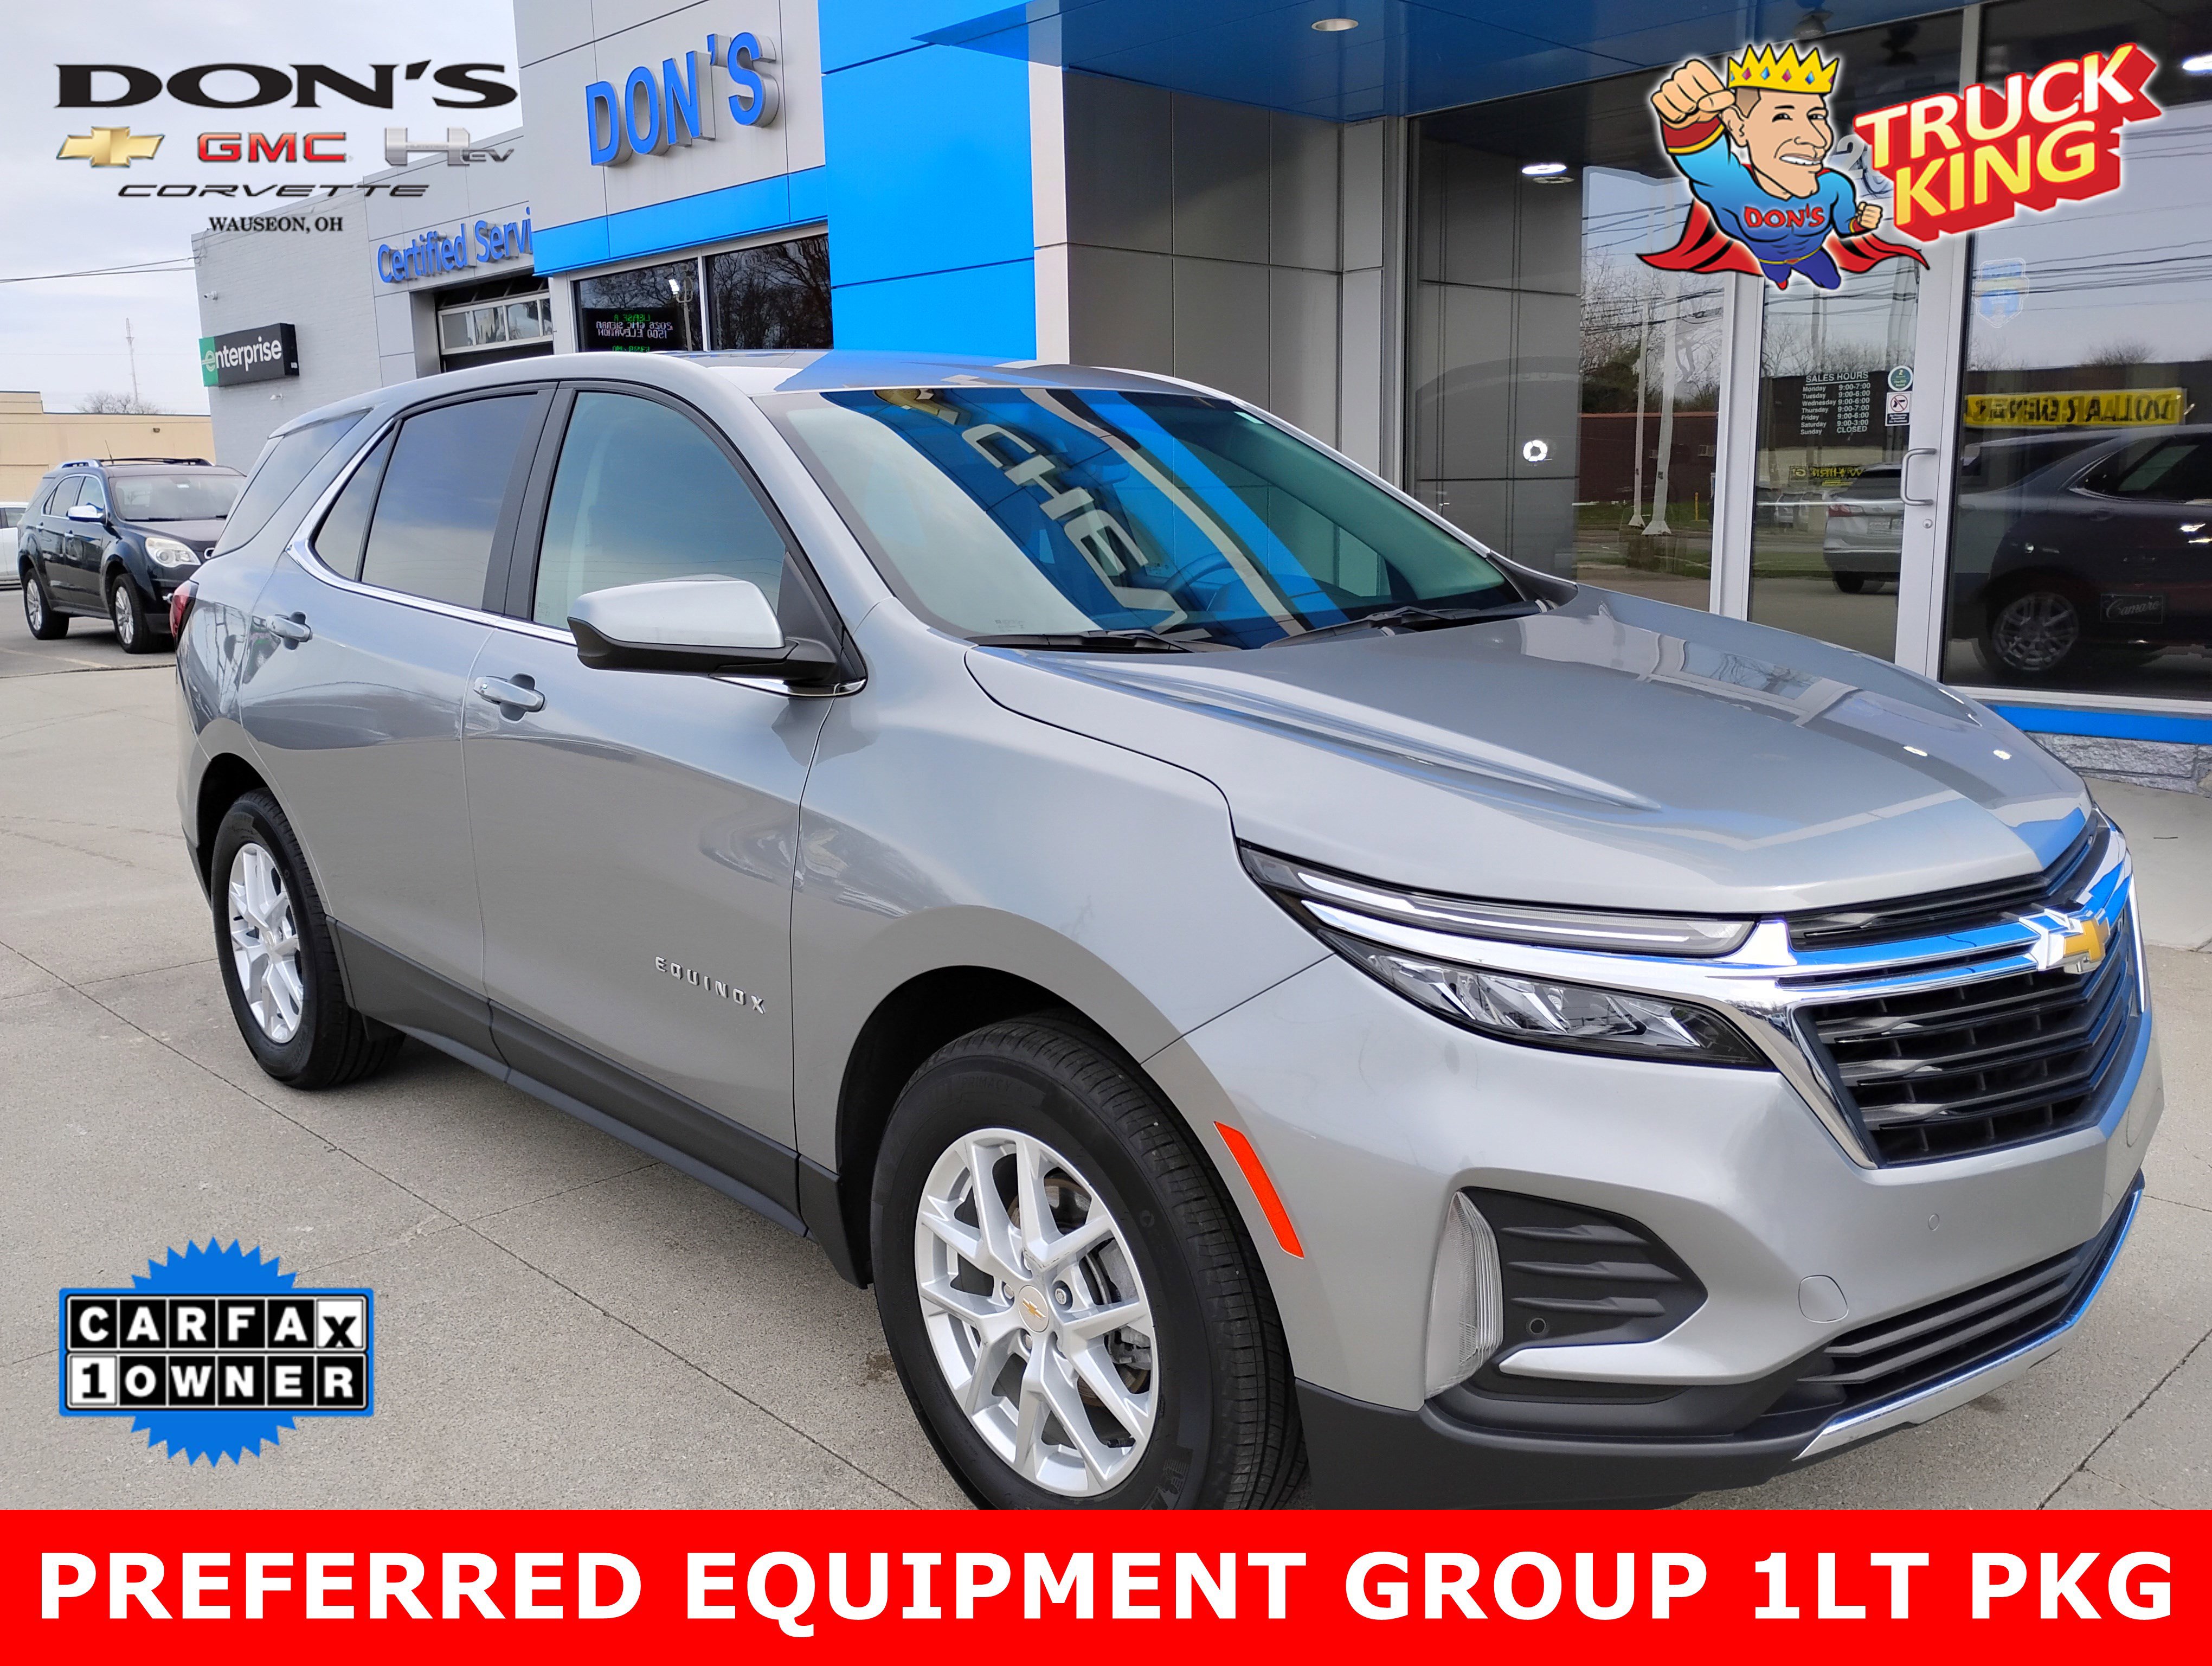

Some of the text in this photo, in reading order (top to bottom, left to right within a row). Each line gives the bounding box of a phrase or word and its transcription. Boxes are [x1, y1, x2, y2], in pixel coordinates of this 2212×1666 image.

[586, 31, 779, 166] DON'S
[377, 223, 468, 284] Certified
[201, 335, 282, 372] enterprise
[1805, 371, 1869, 383] SALES HOURS
[1838, 383, 1871, 391] 9:00-7:00
[1838, 390, 1870, 398] 9:00-6:00
[1837, 405, 1869, 413] 9:00-7:00
[1837, 412, 1869, 420] 9:00-6:00
[2104, 598, 2160, 619] Camaro
[654, 956, 766, 1014] EQUINOX
